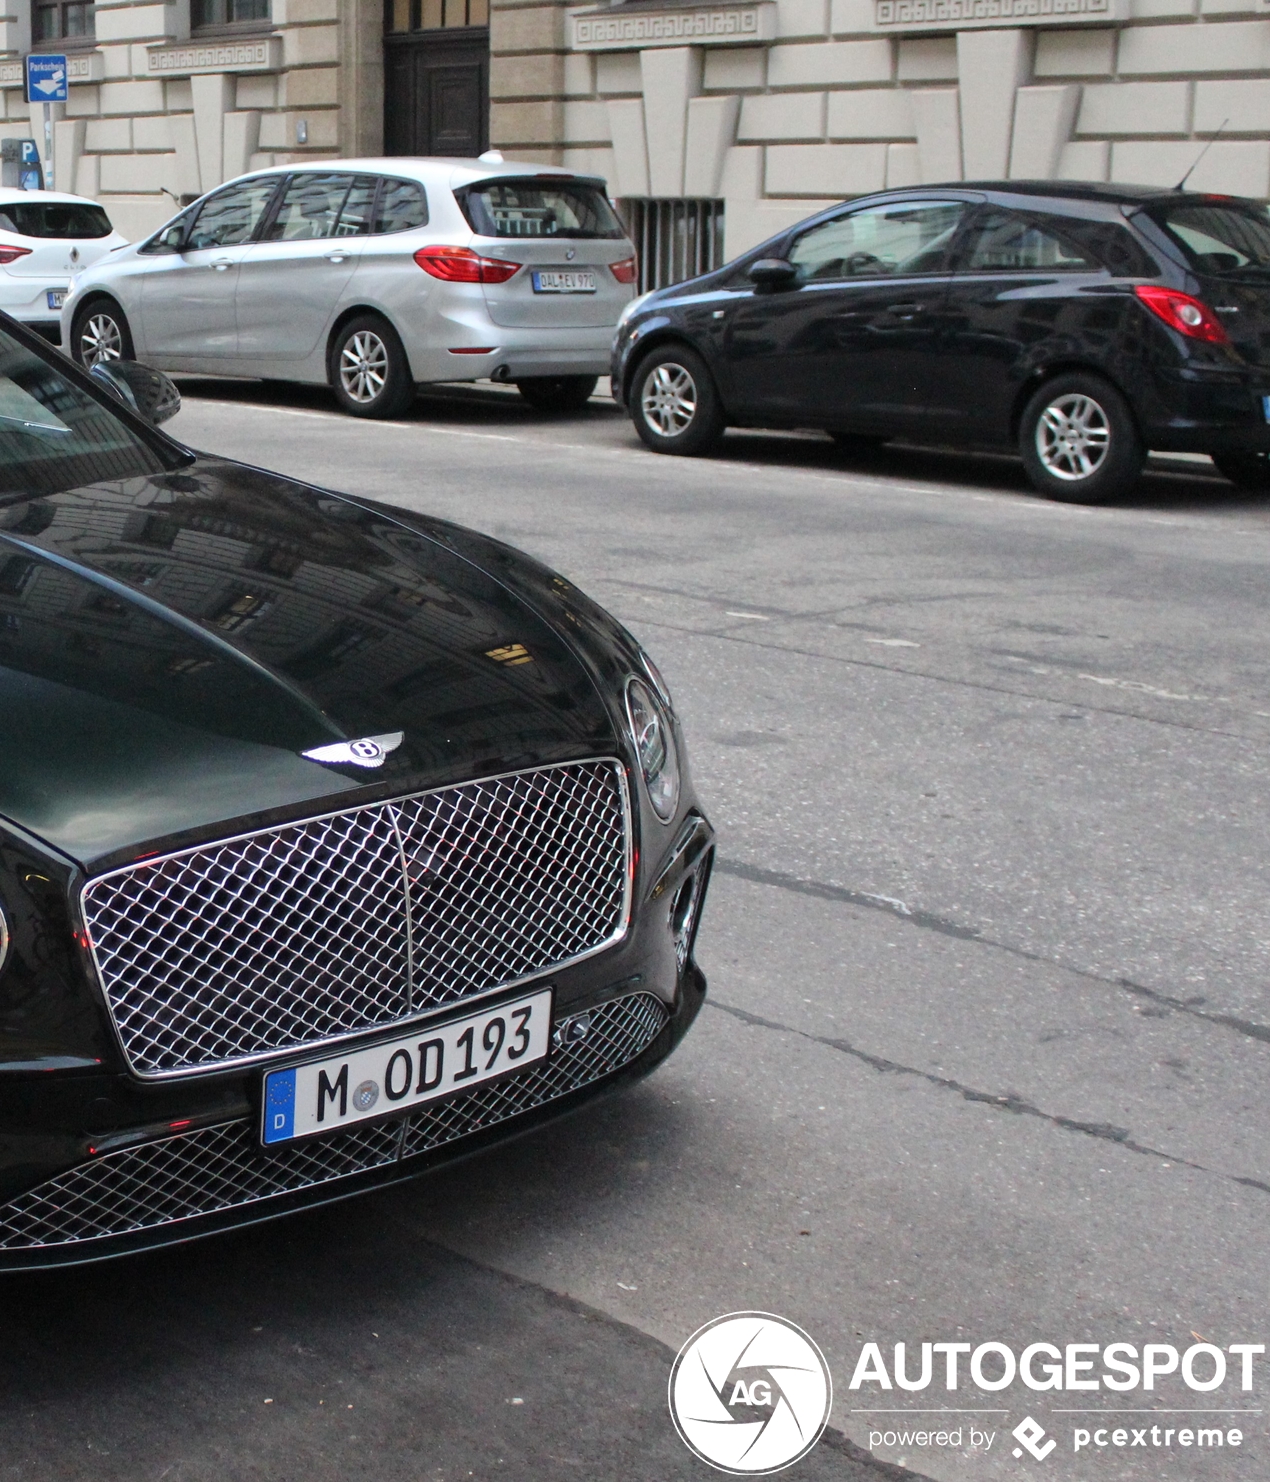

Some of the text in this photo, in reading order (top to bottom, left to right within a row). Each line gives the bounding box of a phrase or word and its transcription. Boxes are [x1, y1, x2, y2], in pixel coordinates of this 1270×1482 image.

[30, 62, 65, 72] Parkschein
[22, 142, 33, 160] P
[317, 1064, 348, 1122] M
[274, 1114, 285, 1130] D
